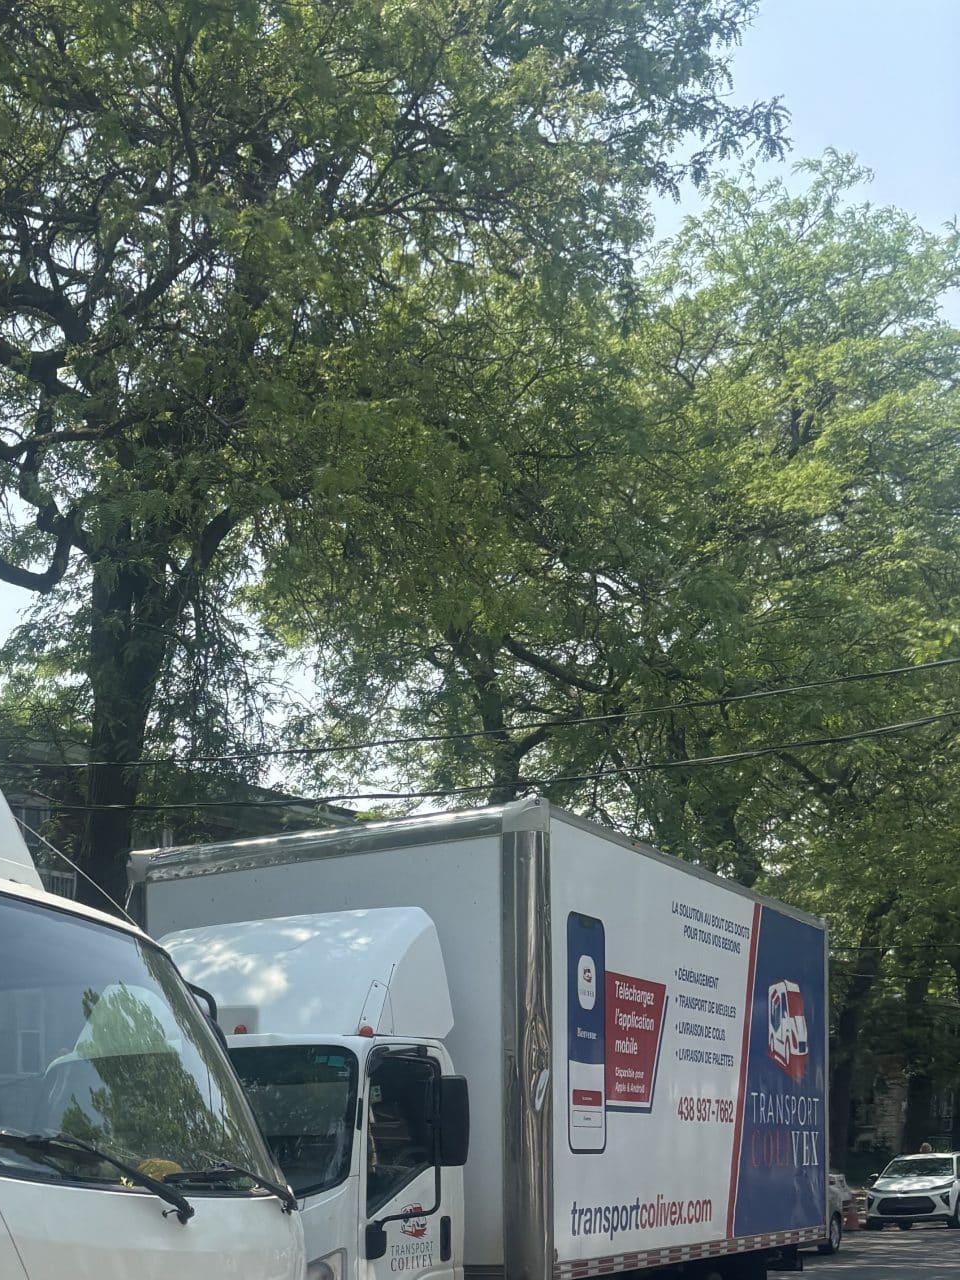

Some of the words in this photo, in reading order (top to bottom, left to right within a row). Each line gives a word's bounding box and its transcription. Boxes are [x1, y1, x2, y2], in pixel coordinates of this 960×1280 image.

[680, 903, 704, 923] SOLUTION
[683, 924, 698, 941] POUR
[698, 929, 712, 945] TOUS
[614, 980, 655, 1008] Téléchargez
[678, 994, 708, 1013] TRANSPORT
[708, 1001, 715, 1014] DE
[614, 1008, 655, 1031] l'application
[678, 1021, 704, 1038] LIVRAISON
[704, 1025, 712, 1039] DE
[614, 1036, 638, 1055] mobile
[678, 1048, 704, 1064] LIVRAISON
[704, 1050, 712, 1065] DE
[677, 1096, 695, 1121] 438
[696, 1097, 734, 1123] 937-7662
[750, 1091, 820, 1126] TRANSPORT
[571, 1193, 713, 1241] transportcolivex.com
[391, 1240, 434, 1257] TRANSPORT
[390, 1253, 433, 1272] COLIVEX
